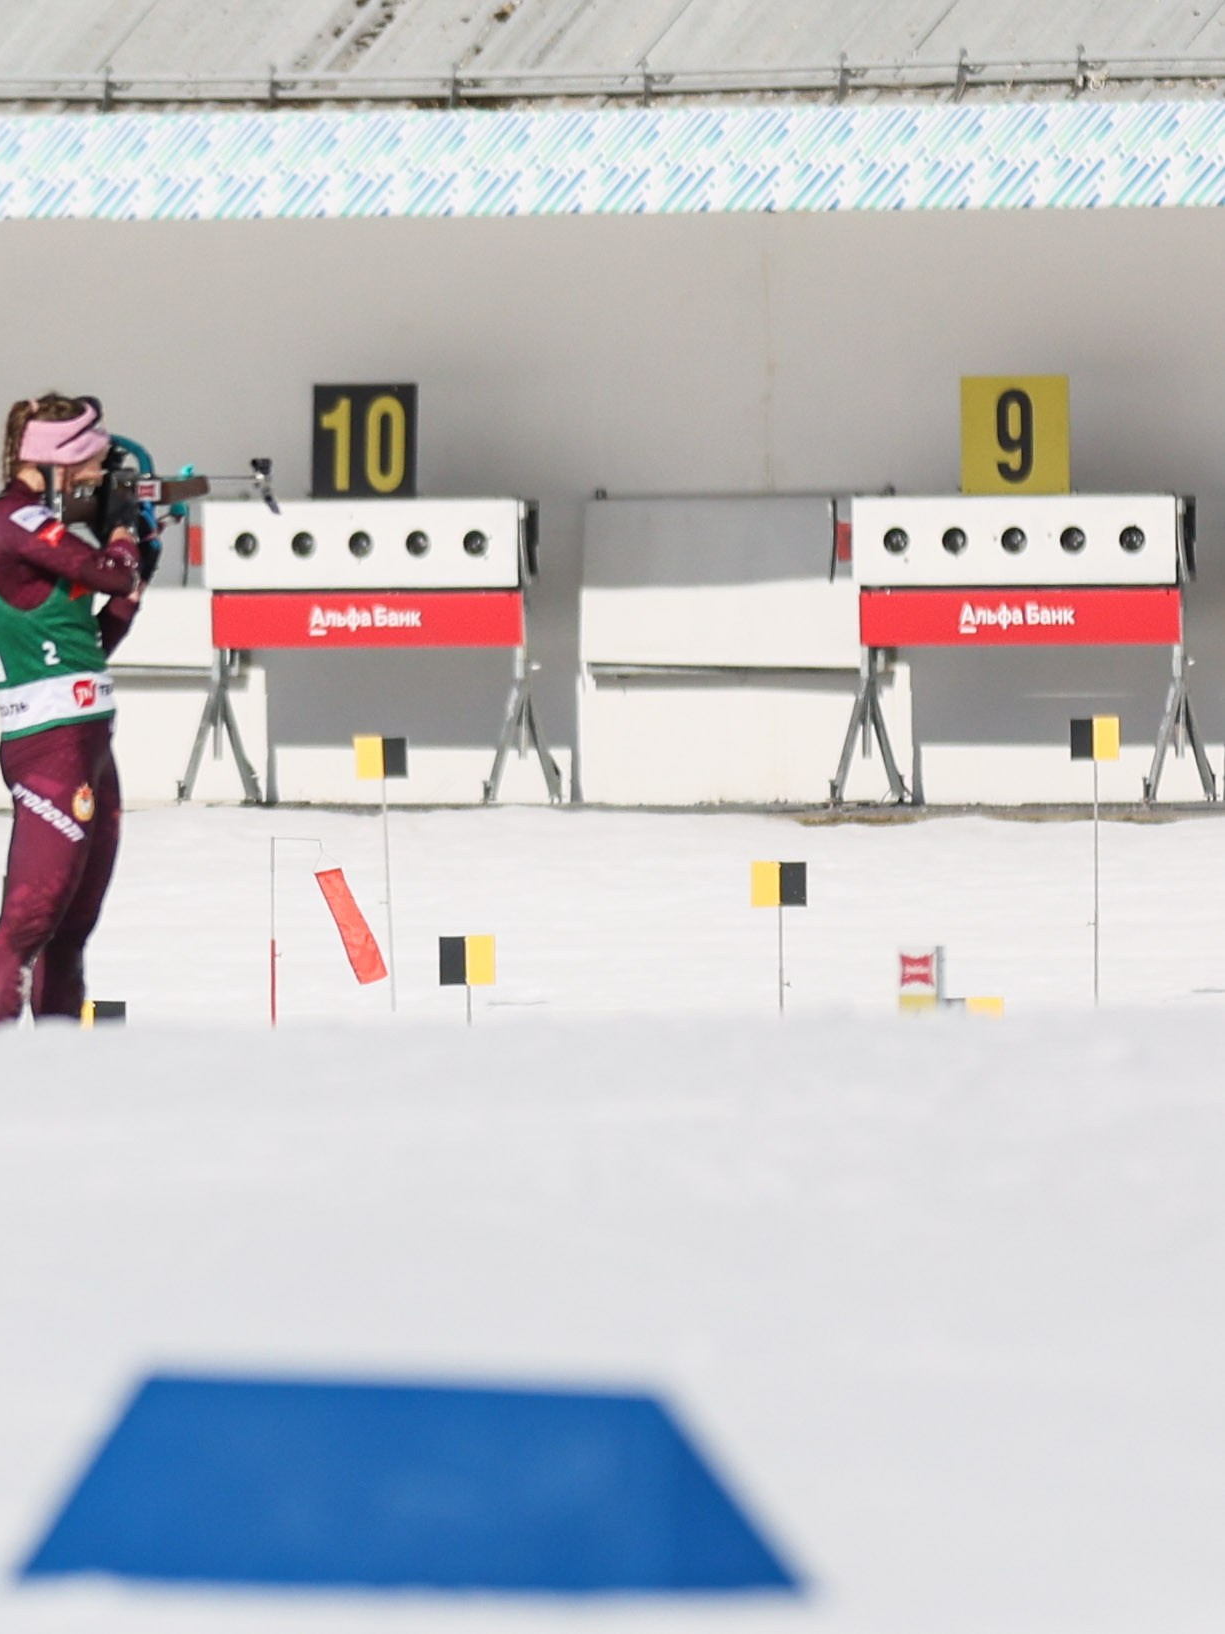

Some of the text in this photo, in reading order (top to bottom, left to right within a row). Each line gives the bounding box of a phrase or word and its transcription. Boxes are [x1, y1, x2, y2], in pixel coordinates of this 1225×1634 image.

[321, 395, 405, 493] 10
[996, 388, 1033, 483] 9
[309, 604, 422, 636] Альфа Банк
[959, 601, 1076, 633] Альфа Банк
[41, 640, 61, 666] 2
